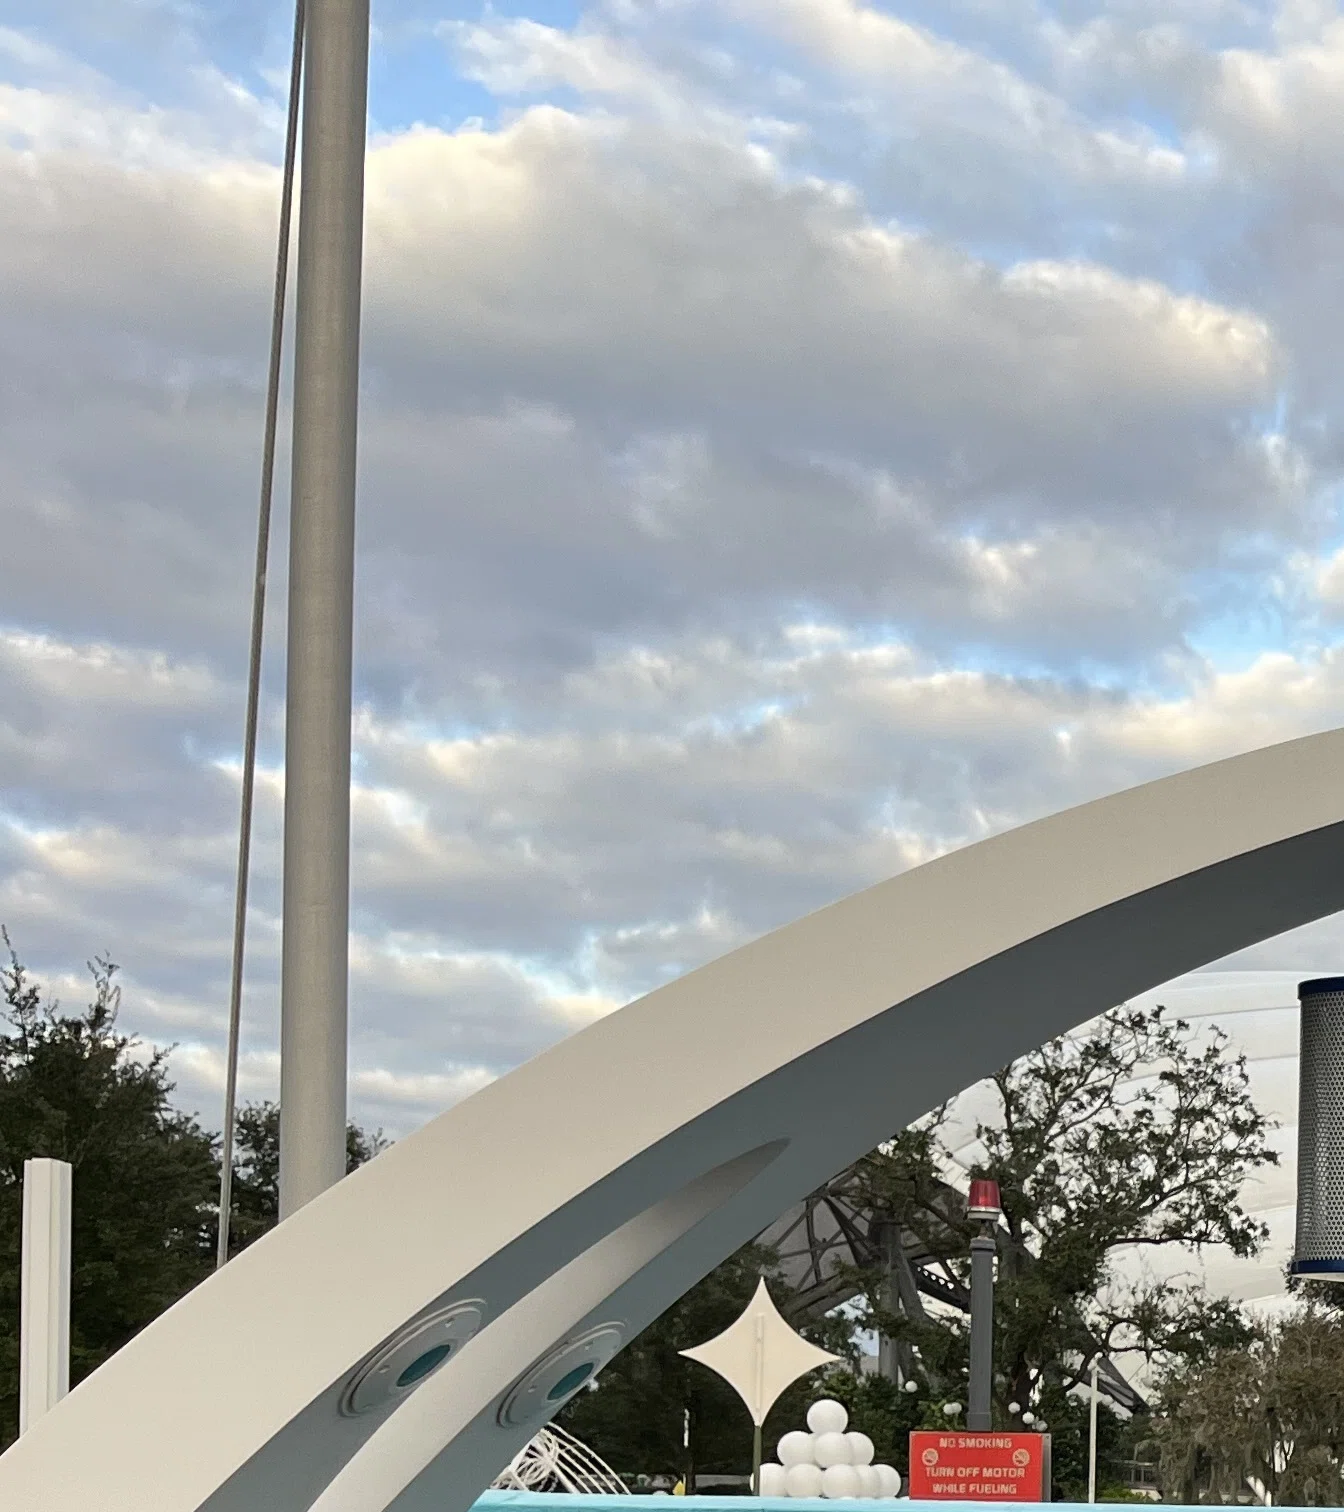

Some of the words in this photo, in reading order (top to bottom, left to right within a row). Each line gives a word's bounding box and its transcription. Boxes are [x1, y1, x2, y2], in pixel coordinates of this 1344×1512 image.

[939, 1437, 957, 1448] NO
[958, 1438, 1013, 1449] SMOKING
[925, 1467, 955, 1478] TURN
[957, 1467, 980, 1478] OFF
[982, 1467, 1026, 1479] MOTOR
[932, 1483, 966, 1494] WHILE
[969, 1483, 1018, 1495] FUELING
